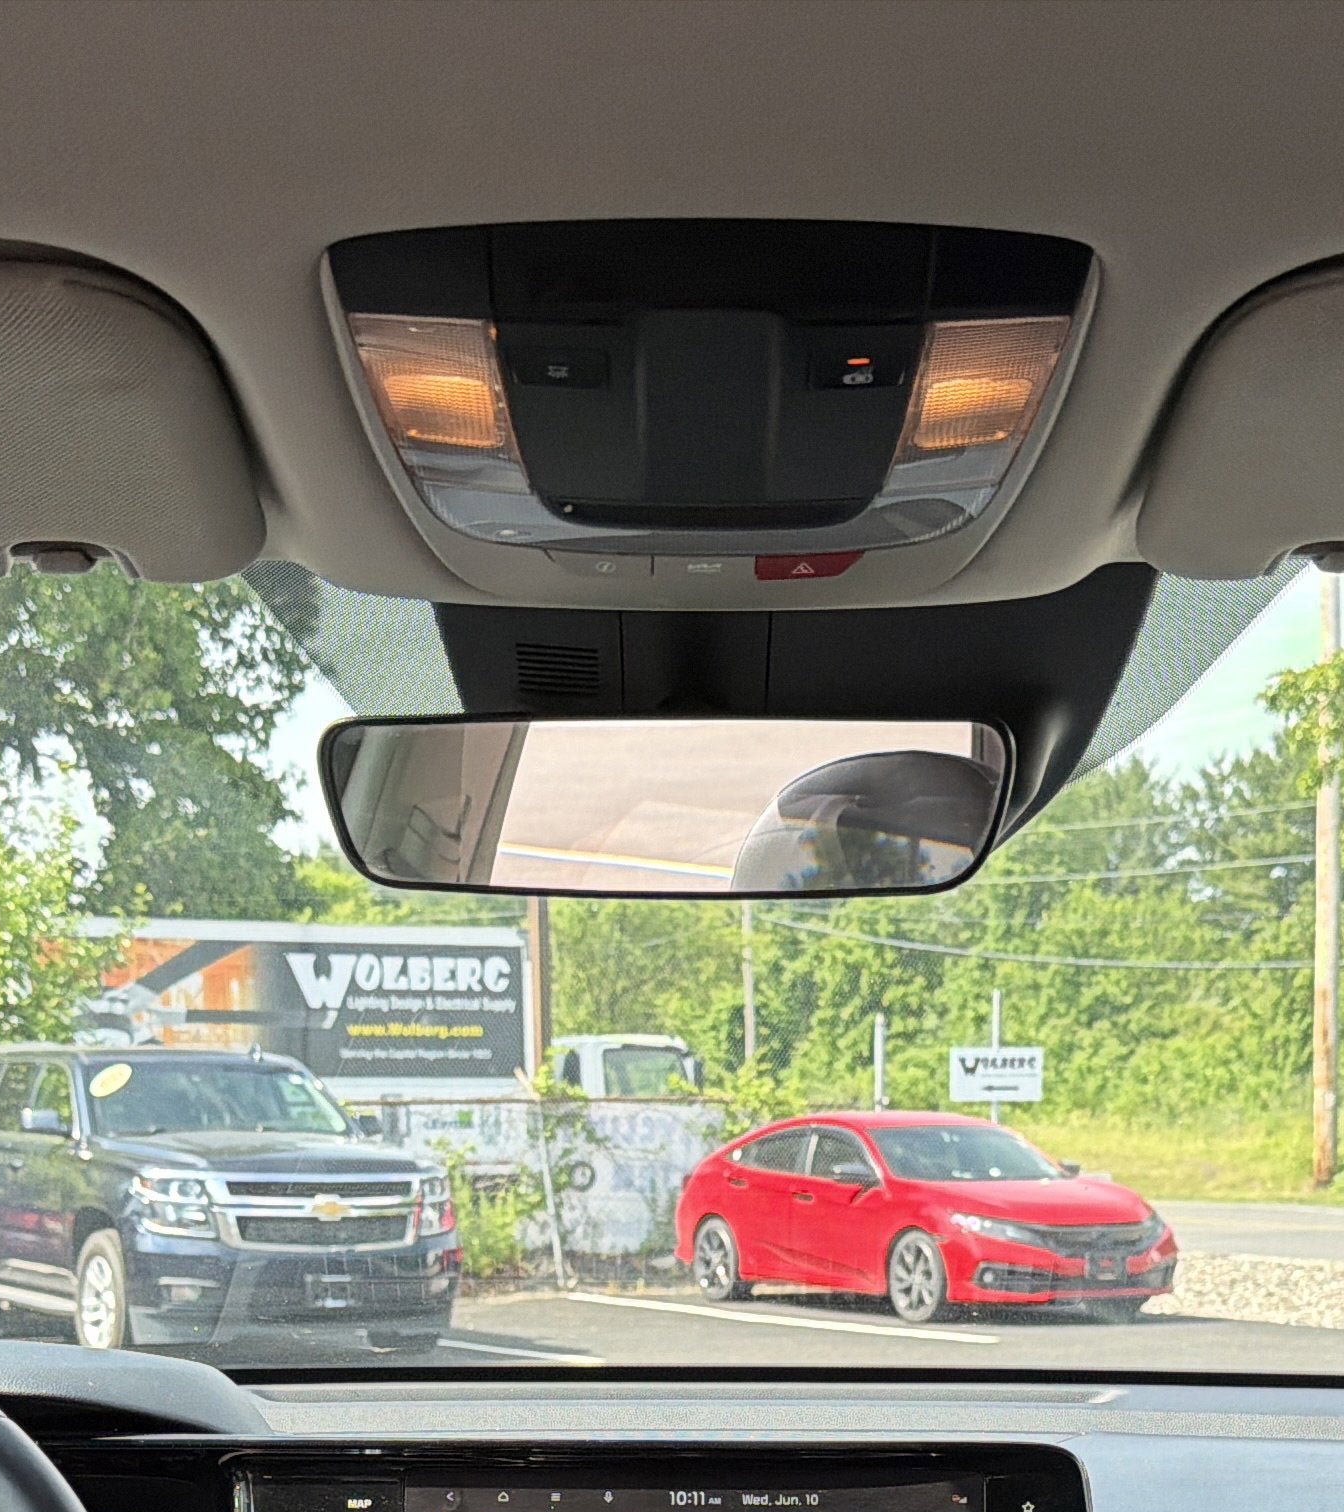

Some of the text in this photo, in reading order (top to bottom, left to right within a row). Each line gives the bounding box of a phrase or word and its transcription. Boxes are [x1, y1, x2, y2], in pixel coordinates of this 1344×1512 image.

[347, 1499, 372, 1509] MAP
[669, 1491, 705, 1506] 10:11
[805, 1494, 819, 1505] 10
